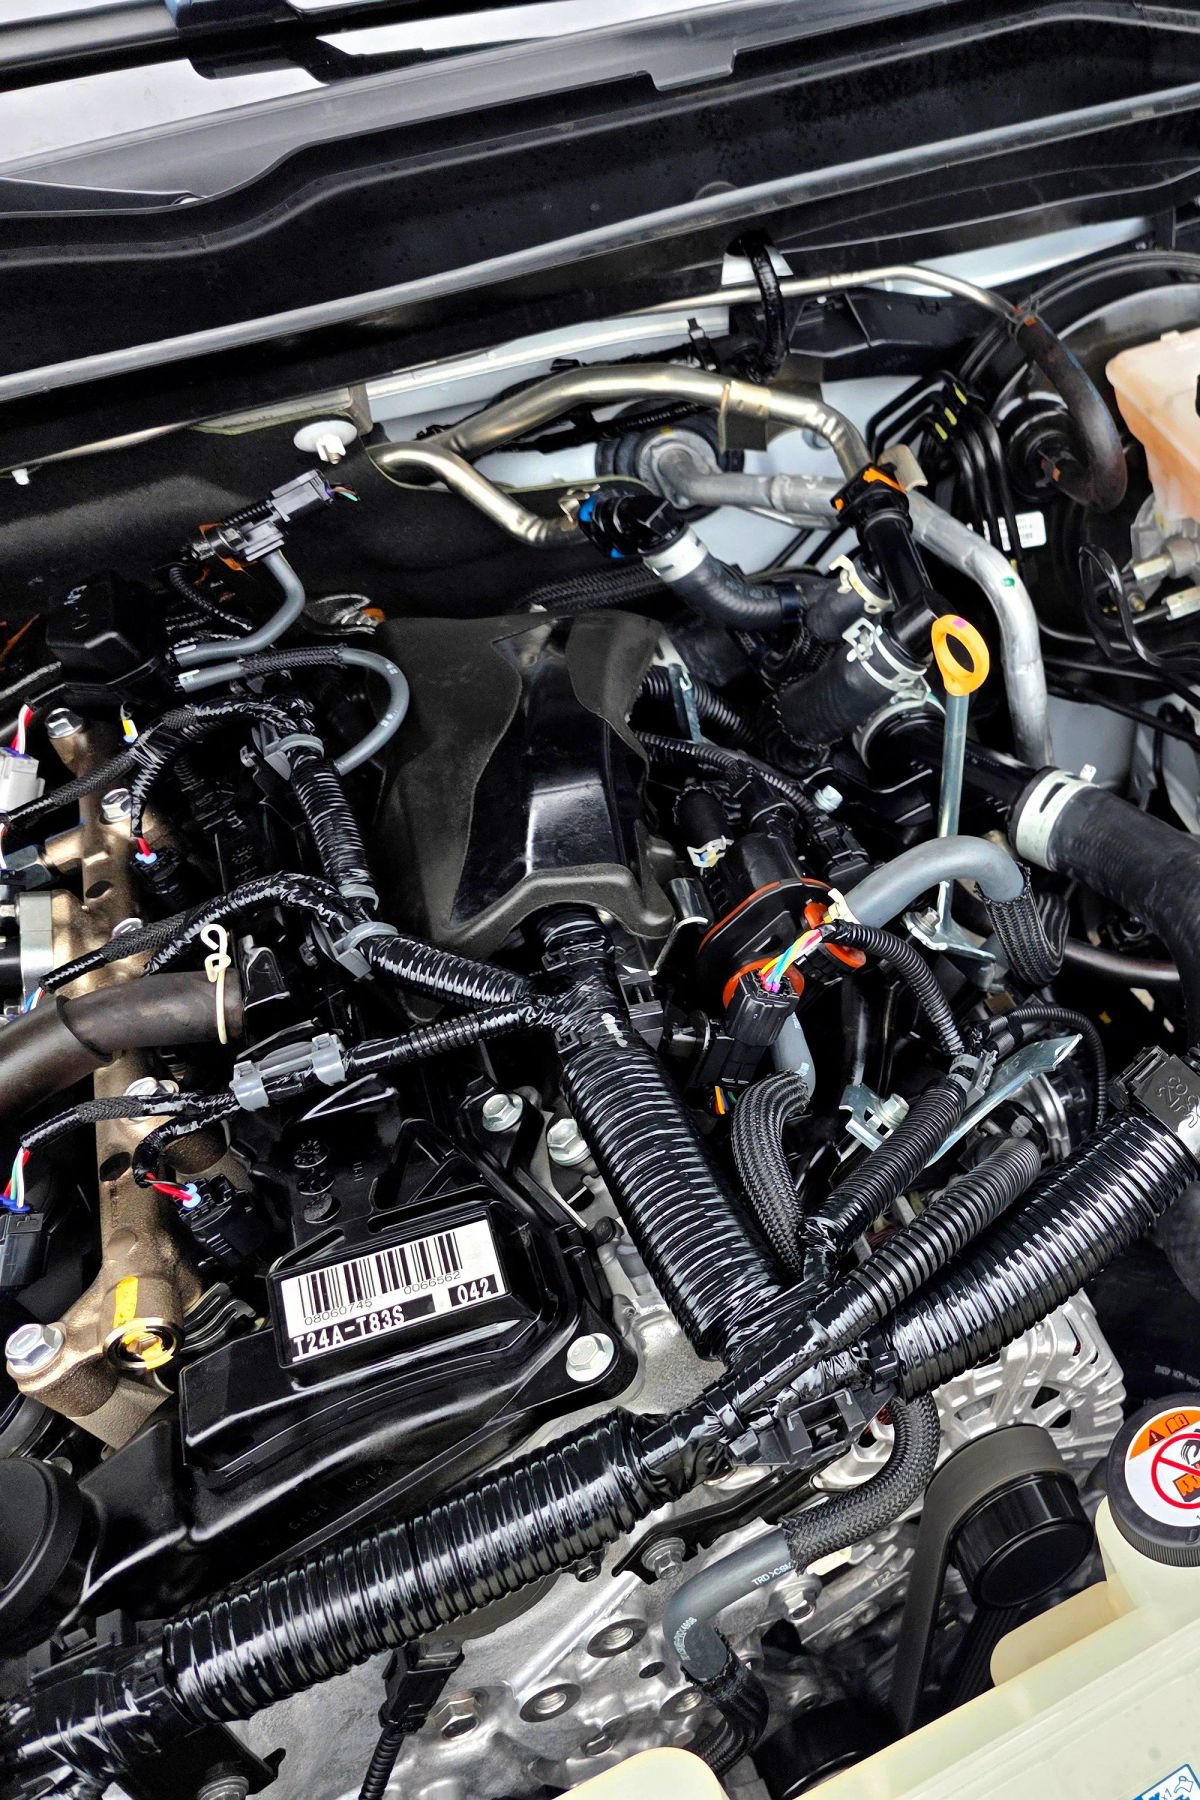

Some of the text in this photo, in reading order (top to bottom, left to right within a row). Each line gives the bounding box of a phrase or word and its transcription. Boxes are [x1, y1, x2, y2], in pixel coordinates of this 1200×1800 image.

[292, 1277, 493, 1352] T24A-T83S 042
[304, 1269, 461, 1326] 08060745 0066562
